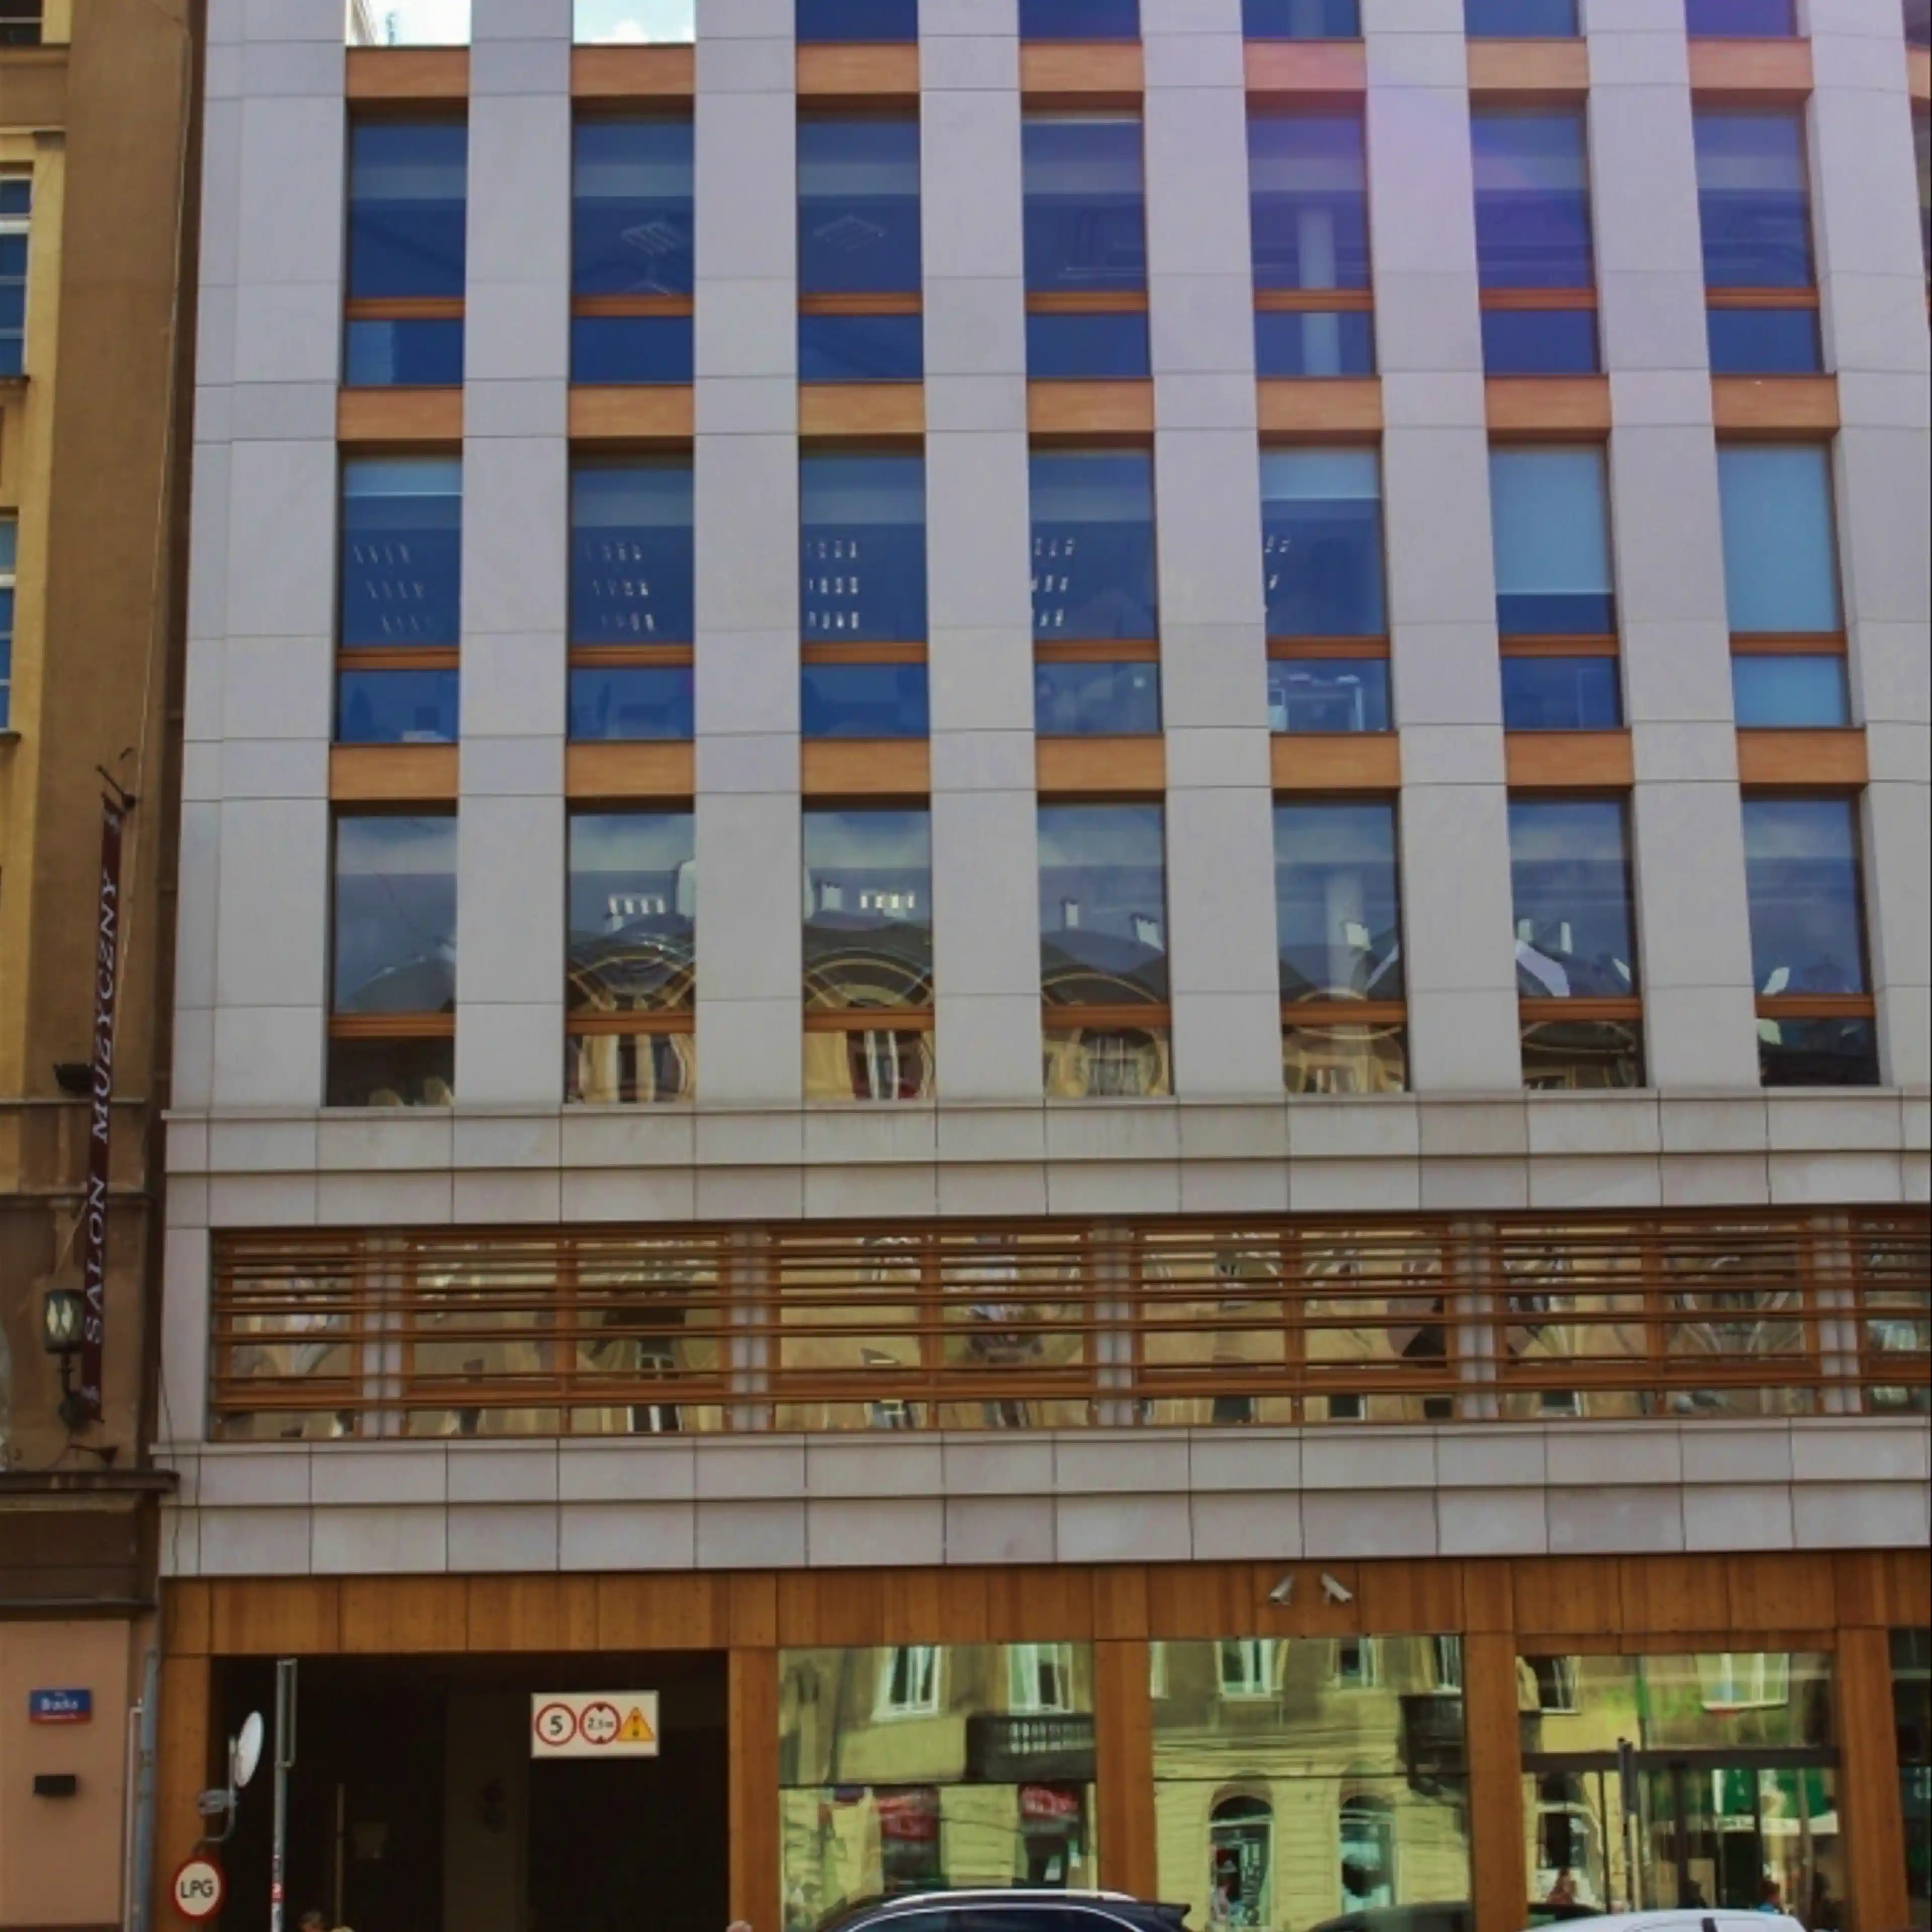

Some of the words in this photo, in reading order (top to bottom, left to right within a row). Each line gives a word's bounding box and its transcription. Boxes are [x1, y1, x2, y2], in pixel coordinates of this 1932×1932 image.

[93, 866, 116, 1144] MUZYCZNY
[86, 1173, 105, 1344] SALON
[549, 1715, 563, 1736] 5
[180, 1879, 214, 1899] LPG
